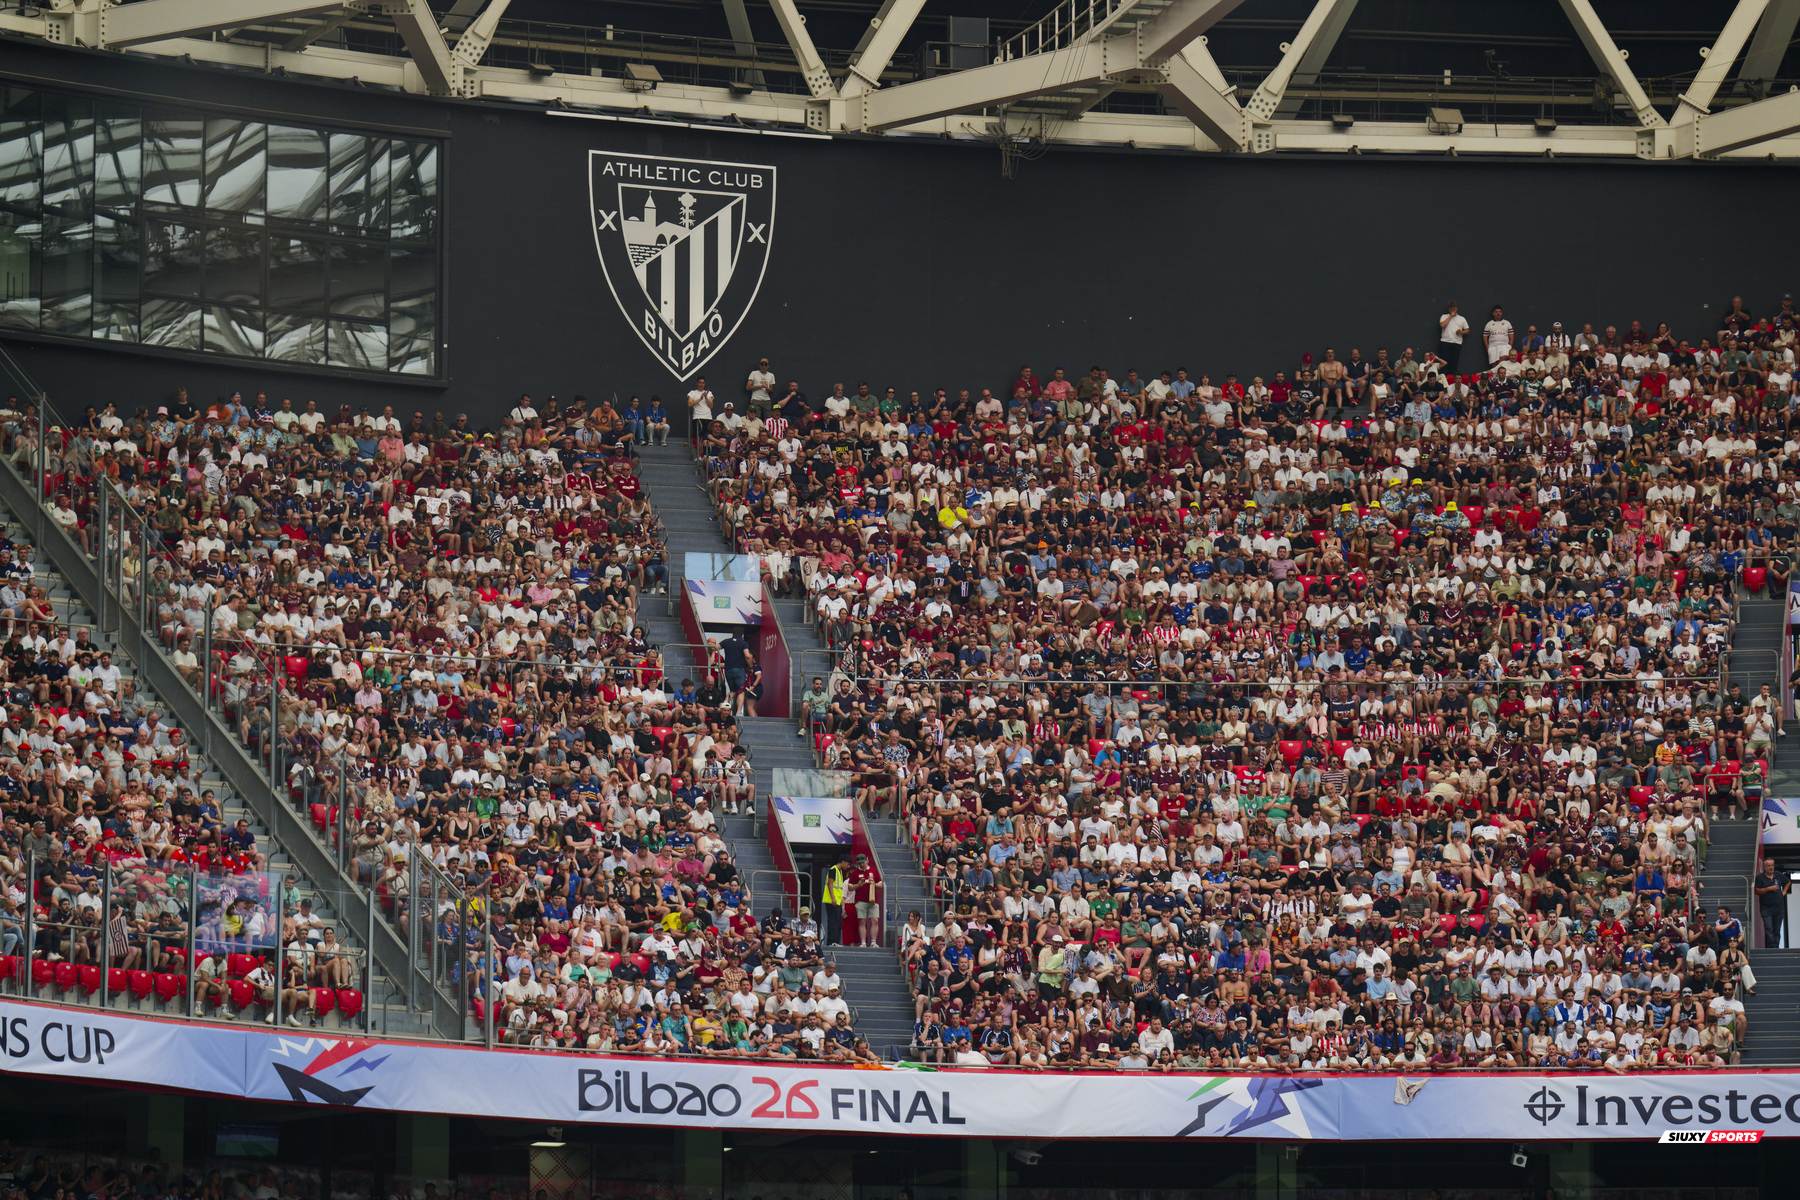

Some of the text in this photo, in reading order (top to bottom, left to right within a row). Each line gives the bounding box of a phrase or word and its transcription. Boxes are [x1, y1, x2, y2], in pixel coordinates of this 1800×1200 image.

[602, 161, 763, 189] ATHLETIC CLUB
[645, 308, 723, 371] BILBAO
[41, 1021, 115, 1065] CUP
[577, 1068, 966, 1125] Bilbao 26 FINAL
